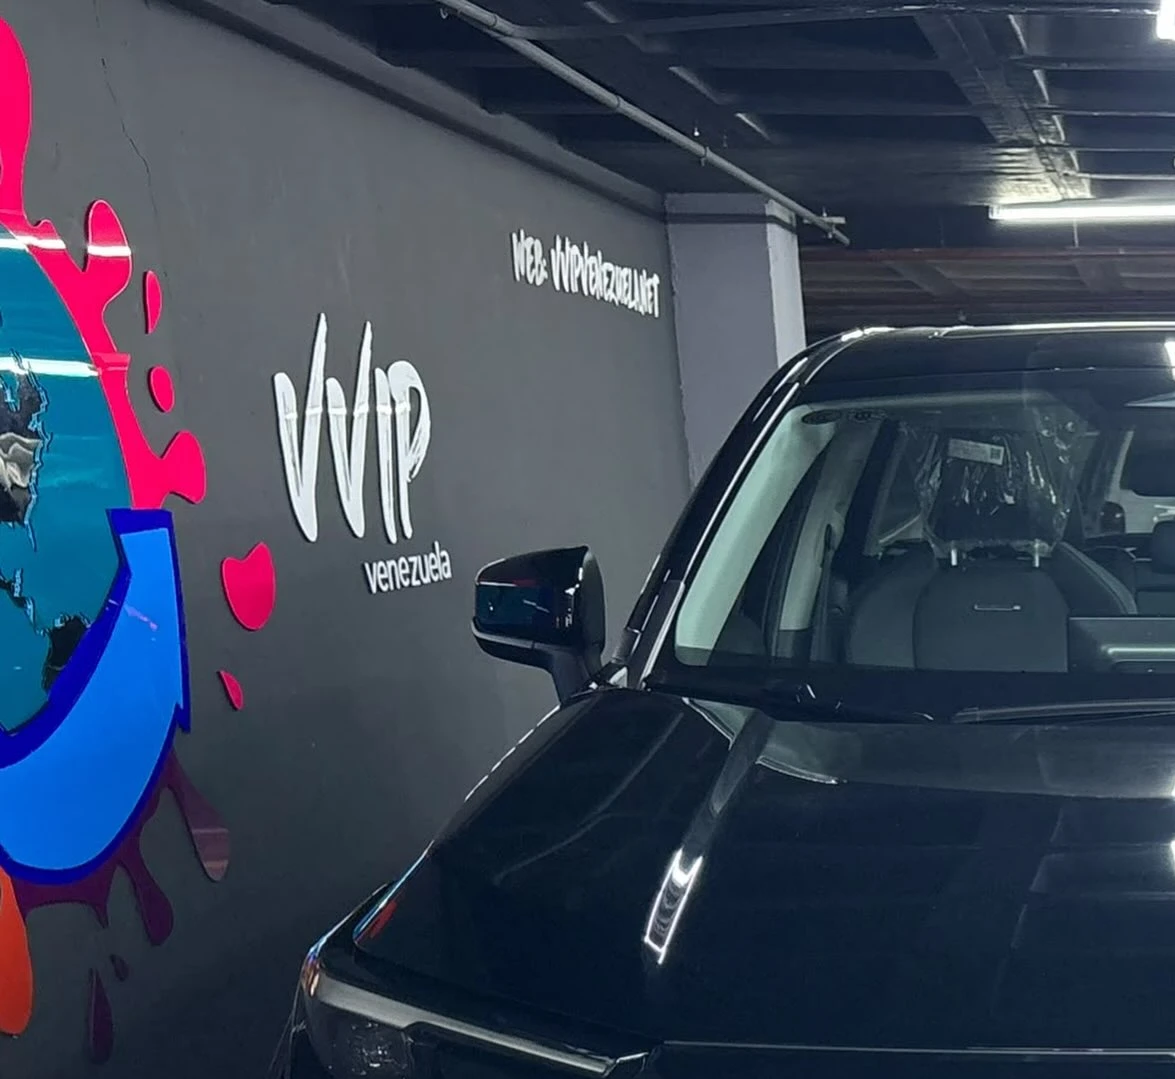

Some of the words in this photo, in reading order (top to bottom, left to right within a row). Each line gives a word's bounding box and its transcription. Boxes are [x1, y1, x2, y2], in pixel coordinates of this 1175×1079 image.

[512, 229, 548, 286] WEB:
[274, 312, 431, 544] VVIP
[364, 540, 452, 593] venezuela
